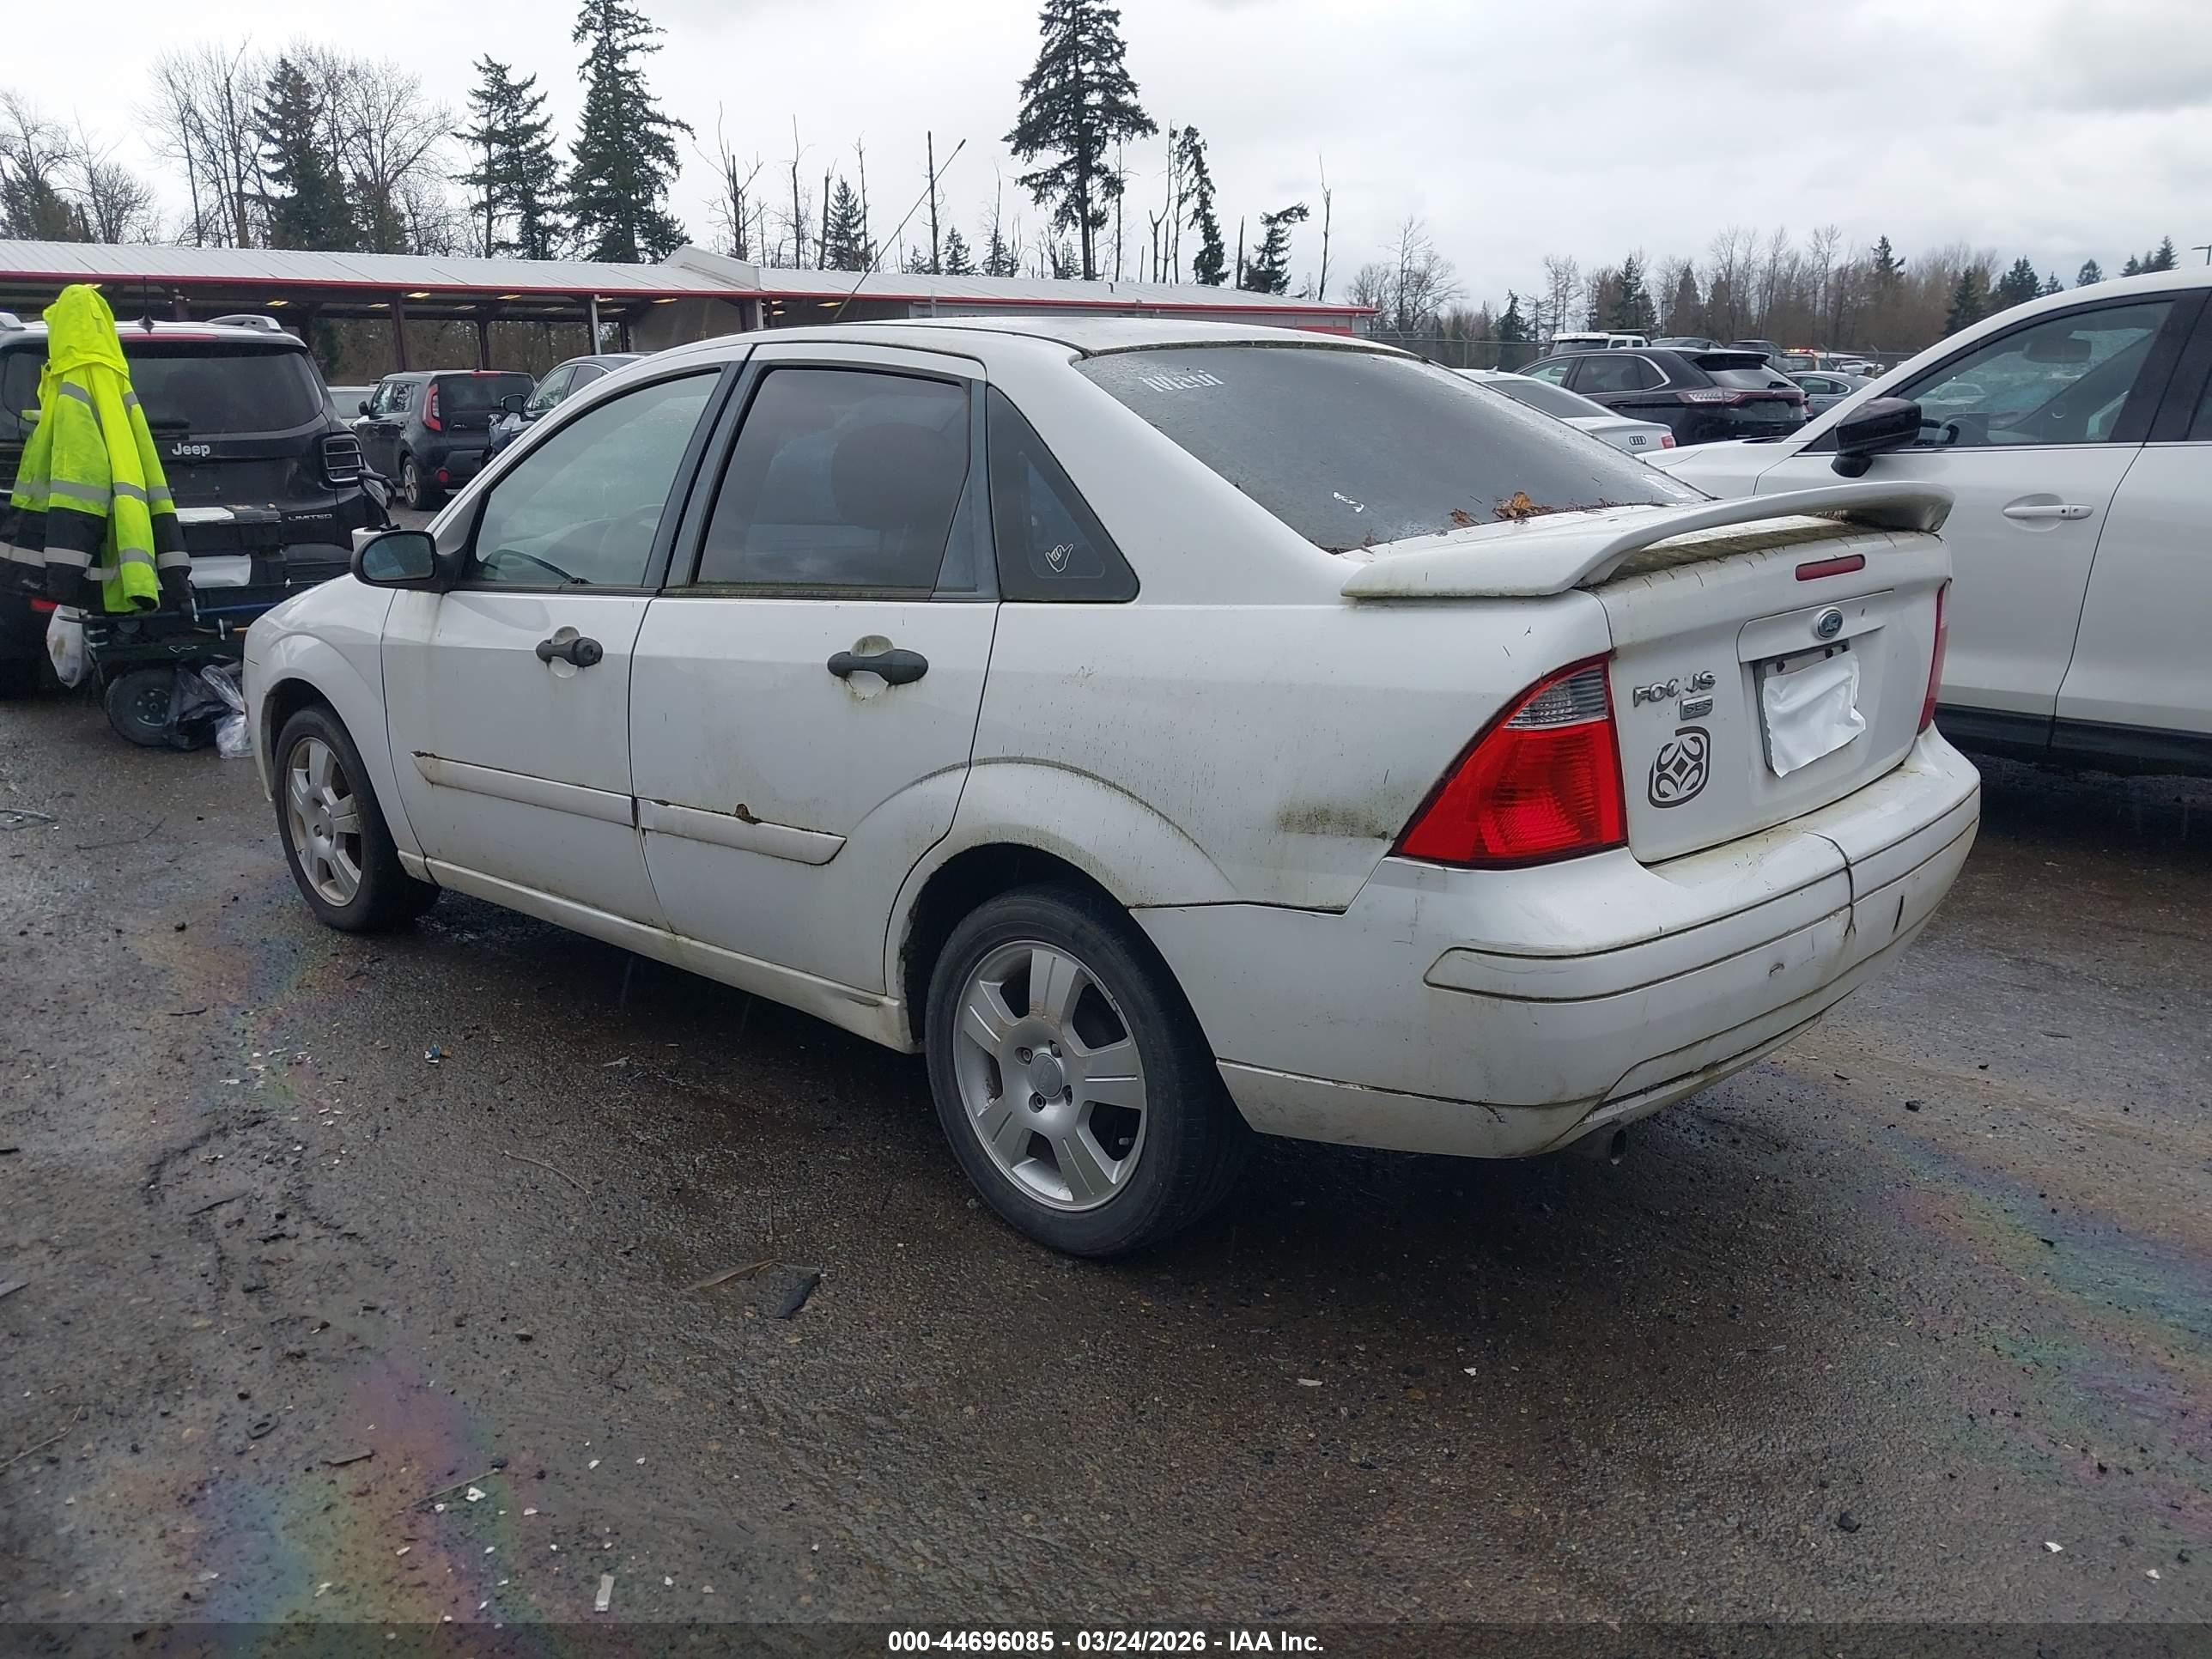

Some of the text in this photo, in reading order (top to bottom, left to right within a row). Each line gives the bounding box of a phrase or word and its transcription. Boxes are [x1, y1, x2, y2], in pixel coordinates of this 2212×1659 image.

[172, 442, 210, 457] Jeep
[288, 513, 333, 522] LIMITED
[1632, 671, 1716, 708] FOCUS
[1685, 699, 1713, 714] SES
